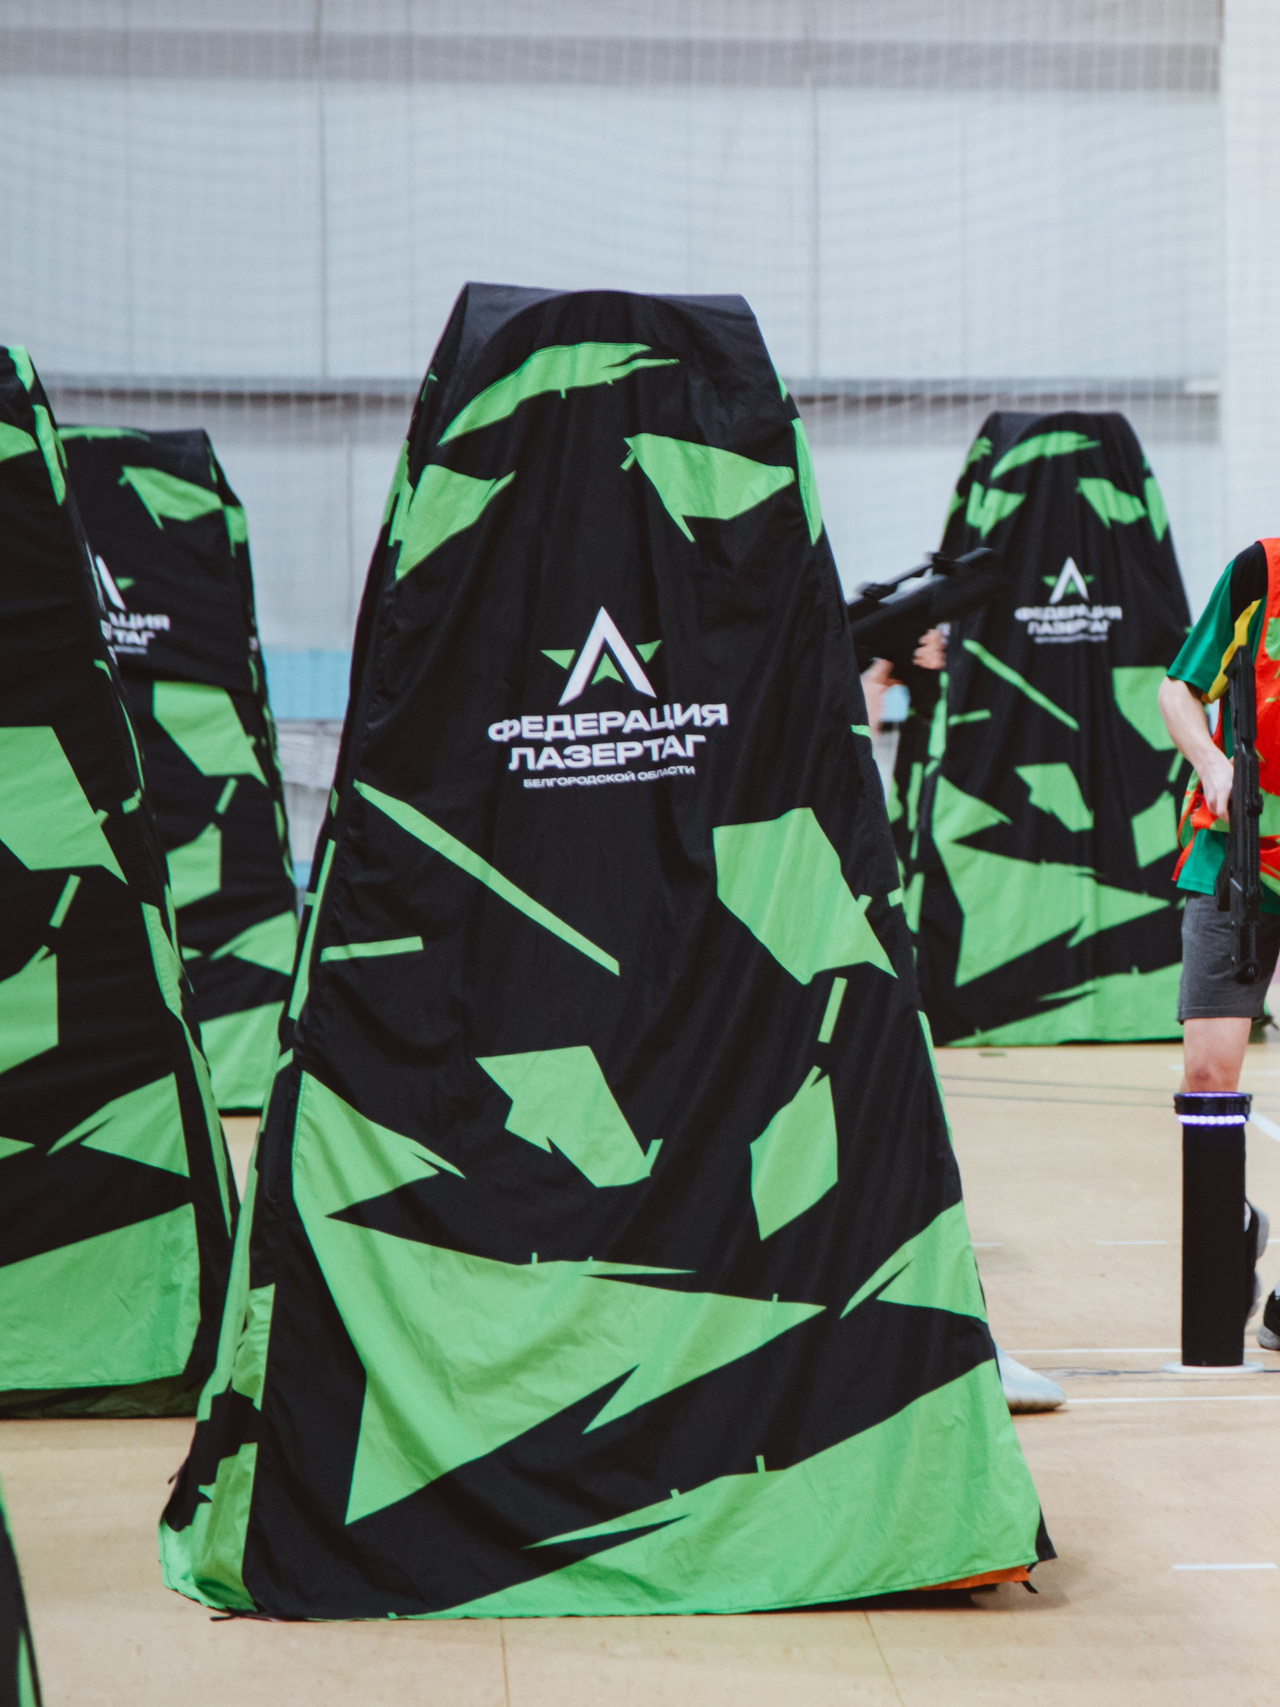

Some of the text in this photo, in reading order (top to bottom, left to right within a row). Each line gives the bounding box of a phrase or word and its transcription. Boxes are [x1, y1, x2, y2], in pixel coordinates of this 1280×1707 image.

[488, 703, 728, 742] ФЕДЕРАЦИЯ
[508, 734, 706, 771] ЛАЗЕРТАГ
[523, 765, 695, 788] БЕЛГОРОДСКОЙ ОБЛАСТИ
